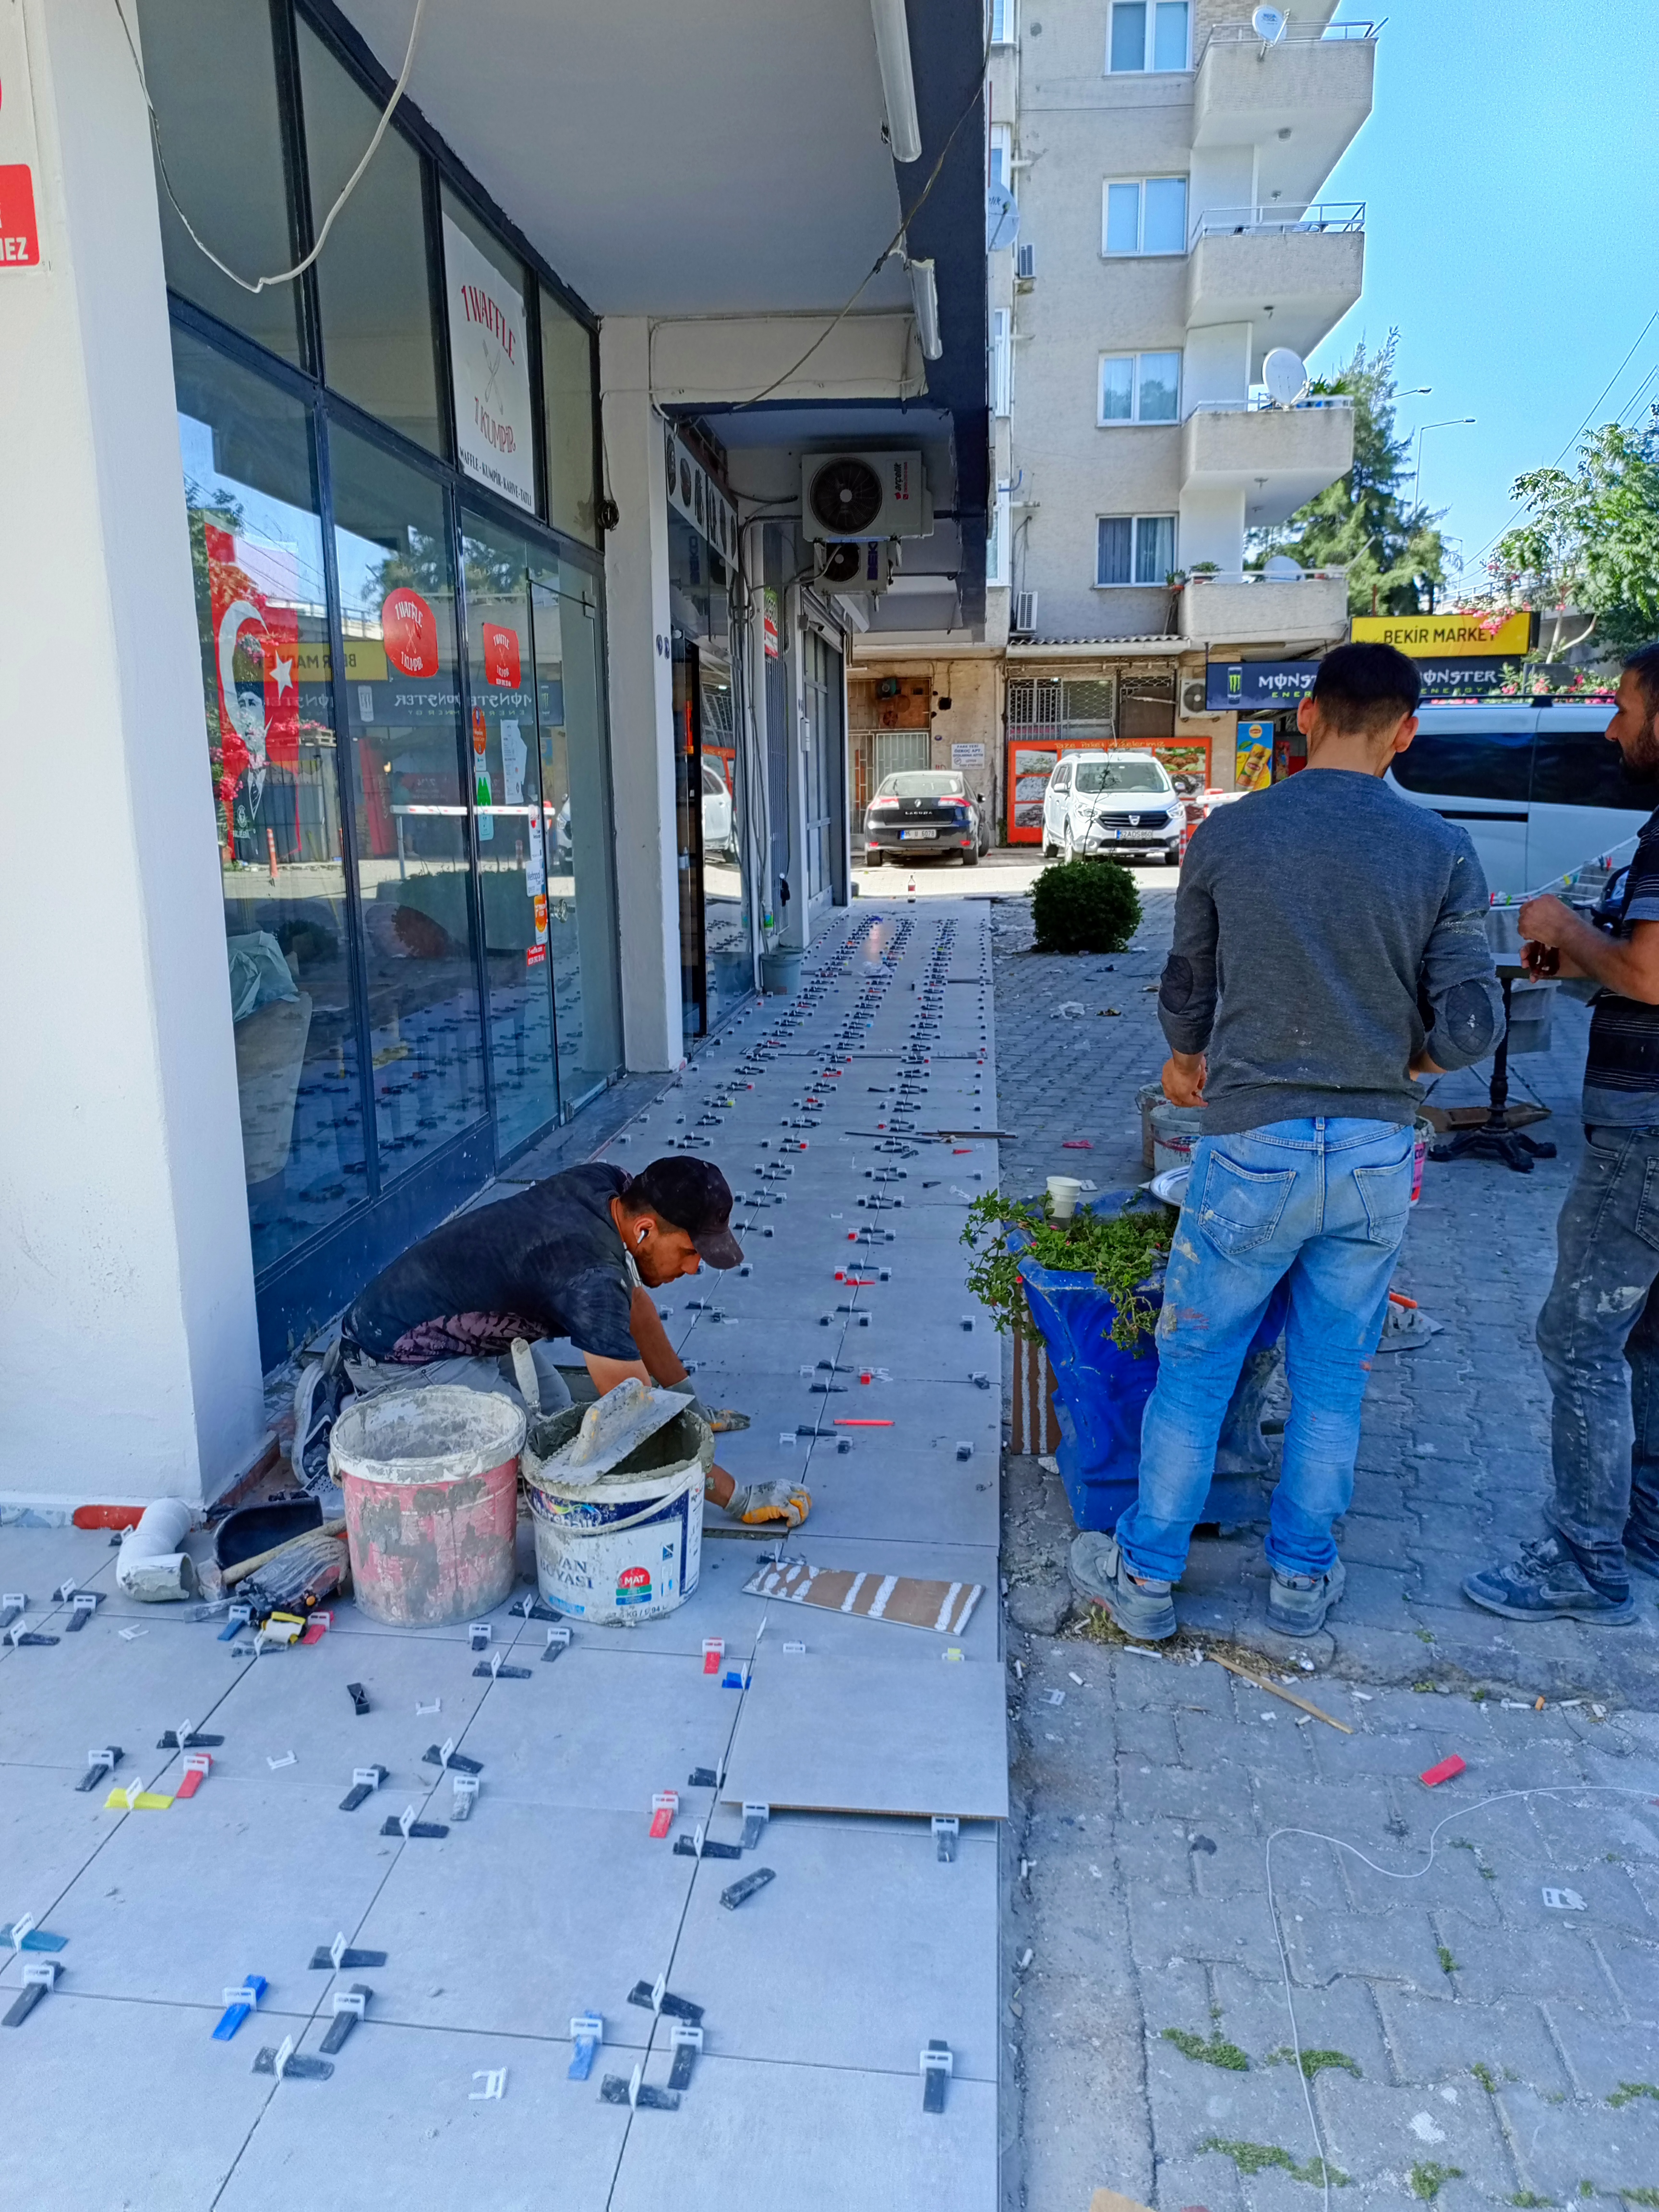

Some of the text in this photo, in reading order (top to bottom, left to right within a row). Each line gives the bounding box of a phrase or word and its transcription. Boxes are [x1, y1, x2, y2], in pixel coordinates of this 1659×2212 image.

[469, 286, 516, 366] WAFFLE
[459, 446, 479, 471] WAFFLE
[1384, 625, 1428, 643] BEKİR
[1259, 673, 1317, 690] MONS
[1420, 668, 1497, 686] ONSTER
[625, 1575, 645, 1586] MAT
